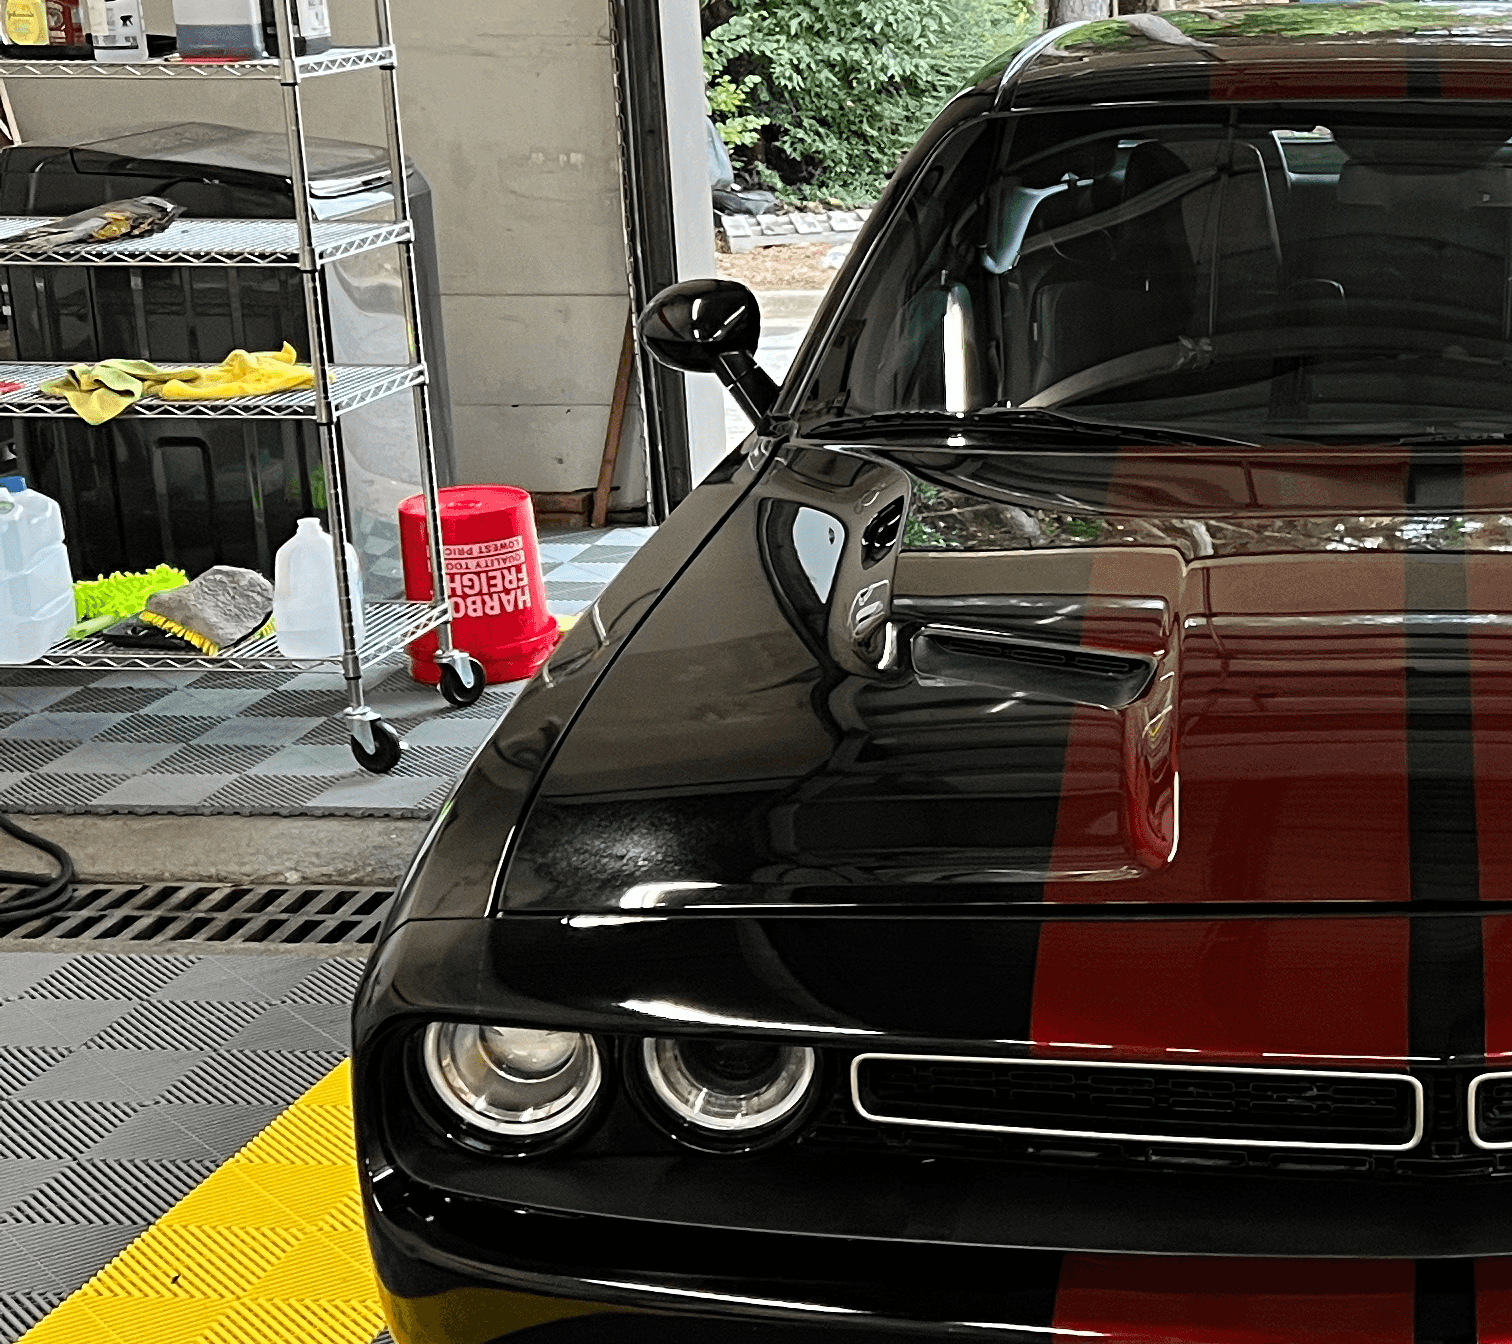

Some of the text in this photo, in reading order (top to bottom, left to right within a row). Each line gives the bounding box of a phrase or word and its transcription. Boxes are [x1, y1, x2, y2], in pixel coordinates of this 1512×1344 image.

[444, 538, 520, 556] LOWEST PRIC
[445, 552, 521, 571] QUALITY TOO
[447, 563, 529, 596] FREIGH
[451, 585, 531, 618] HARBO
